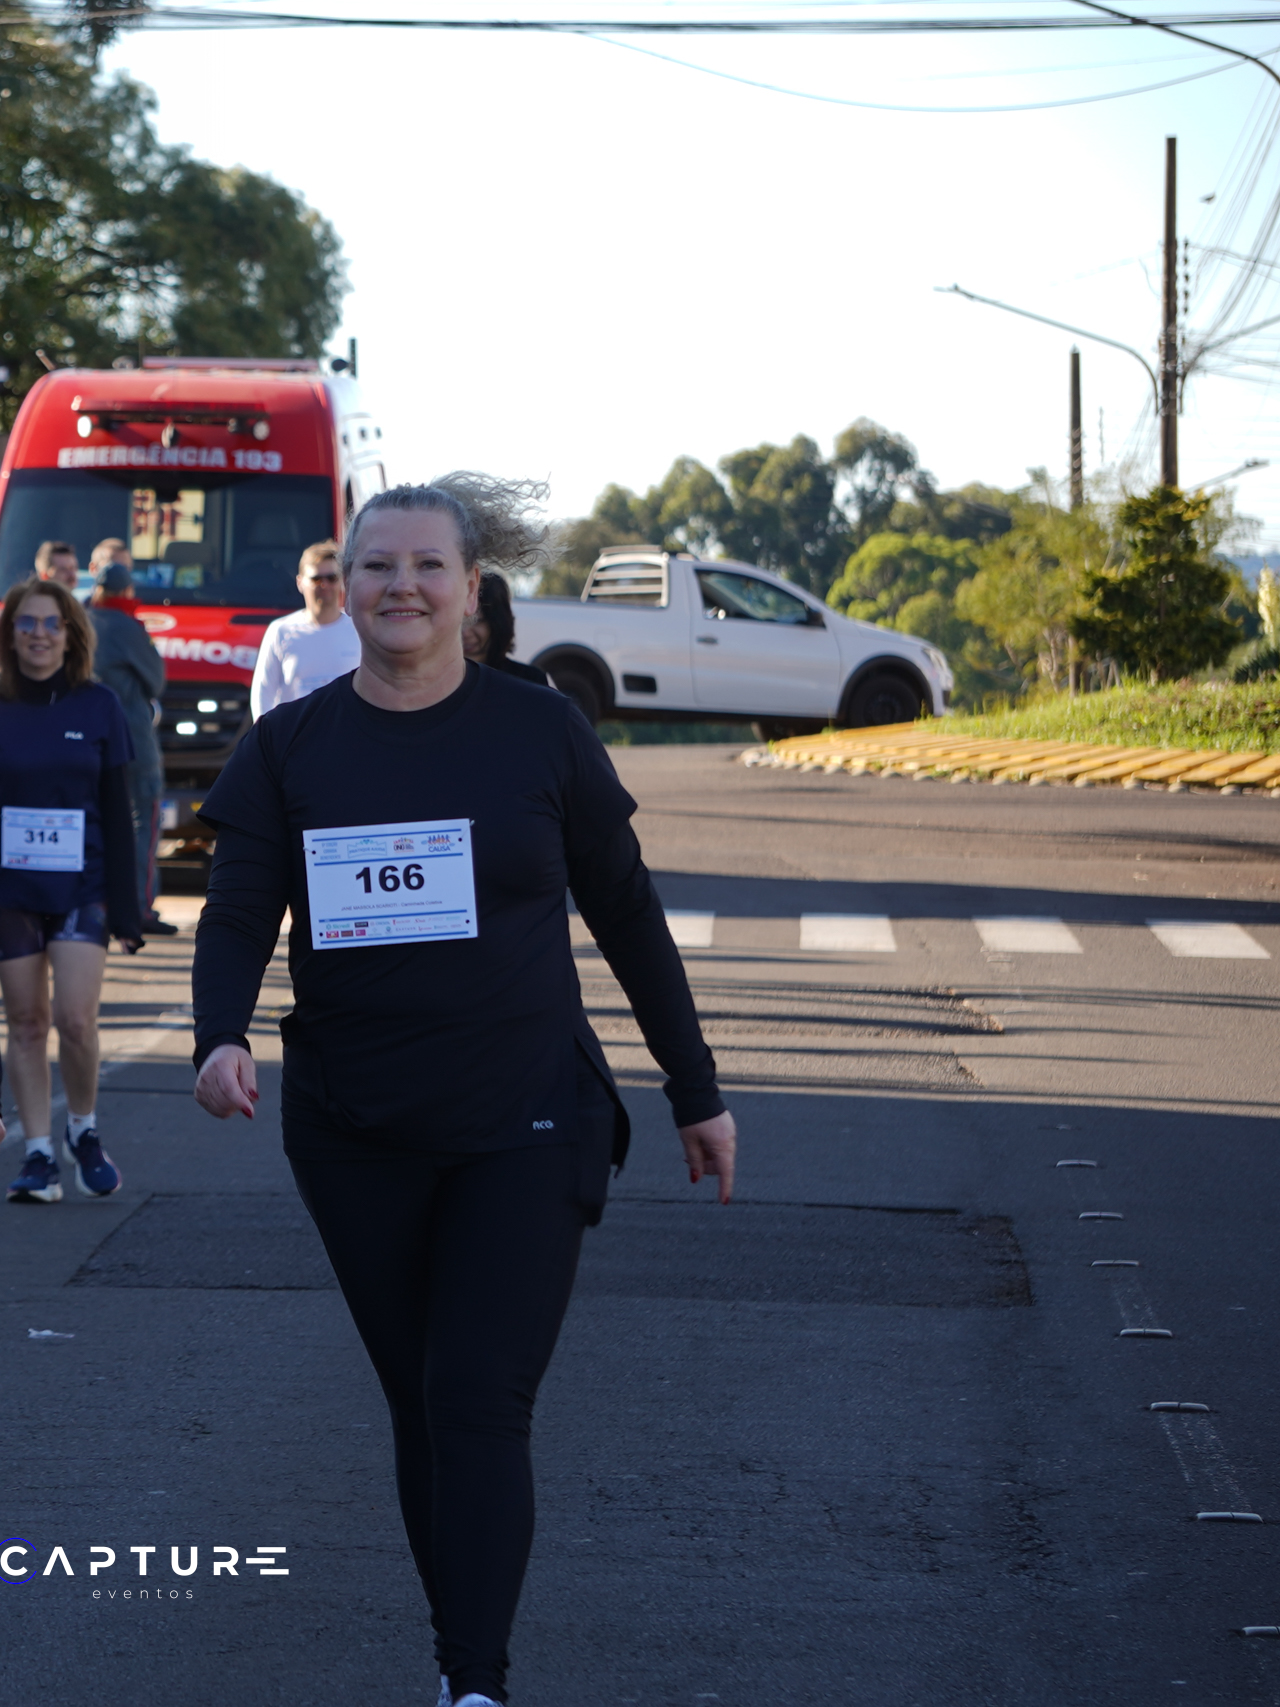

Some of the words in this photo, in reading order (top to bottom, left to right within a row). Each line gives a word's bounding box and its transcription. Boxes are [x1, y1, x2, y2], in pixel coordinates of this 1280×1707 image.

[57, 443, 227, 468] EMERGÊNCIA
[232, 449, 283, 472] 193
[23, 829, 59, 844] 314
[355, 863, 425, 894] 166
